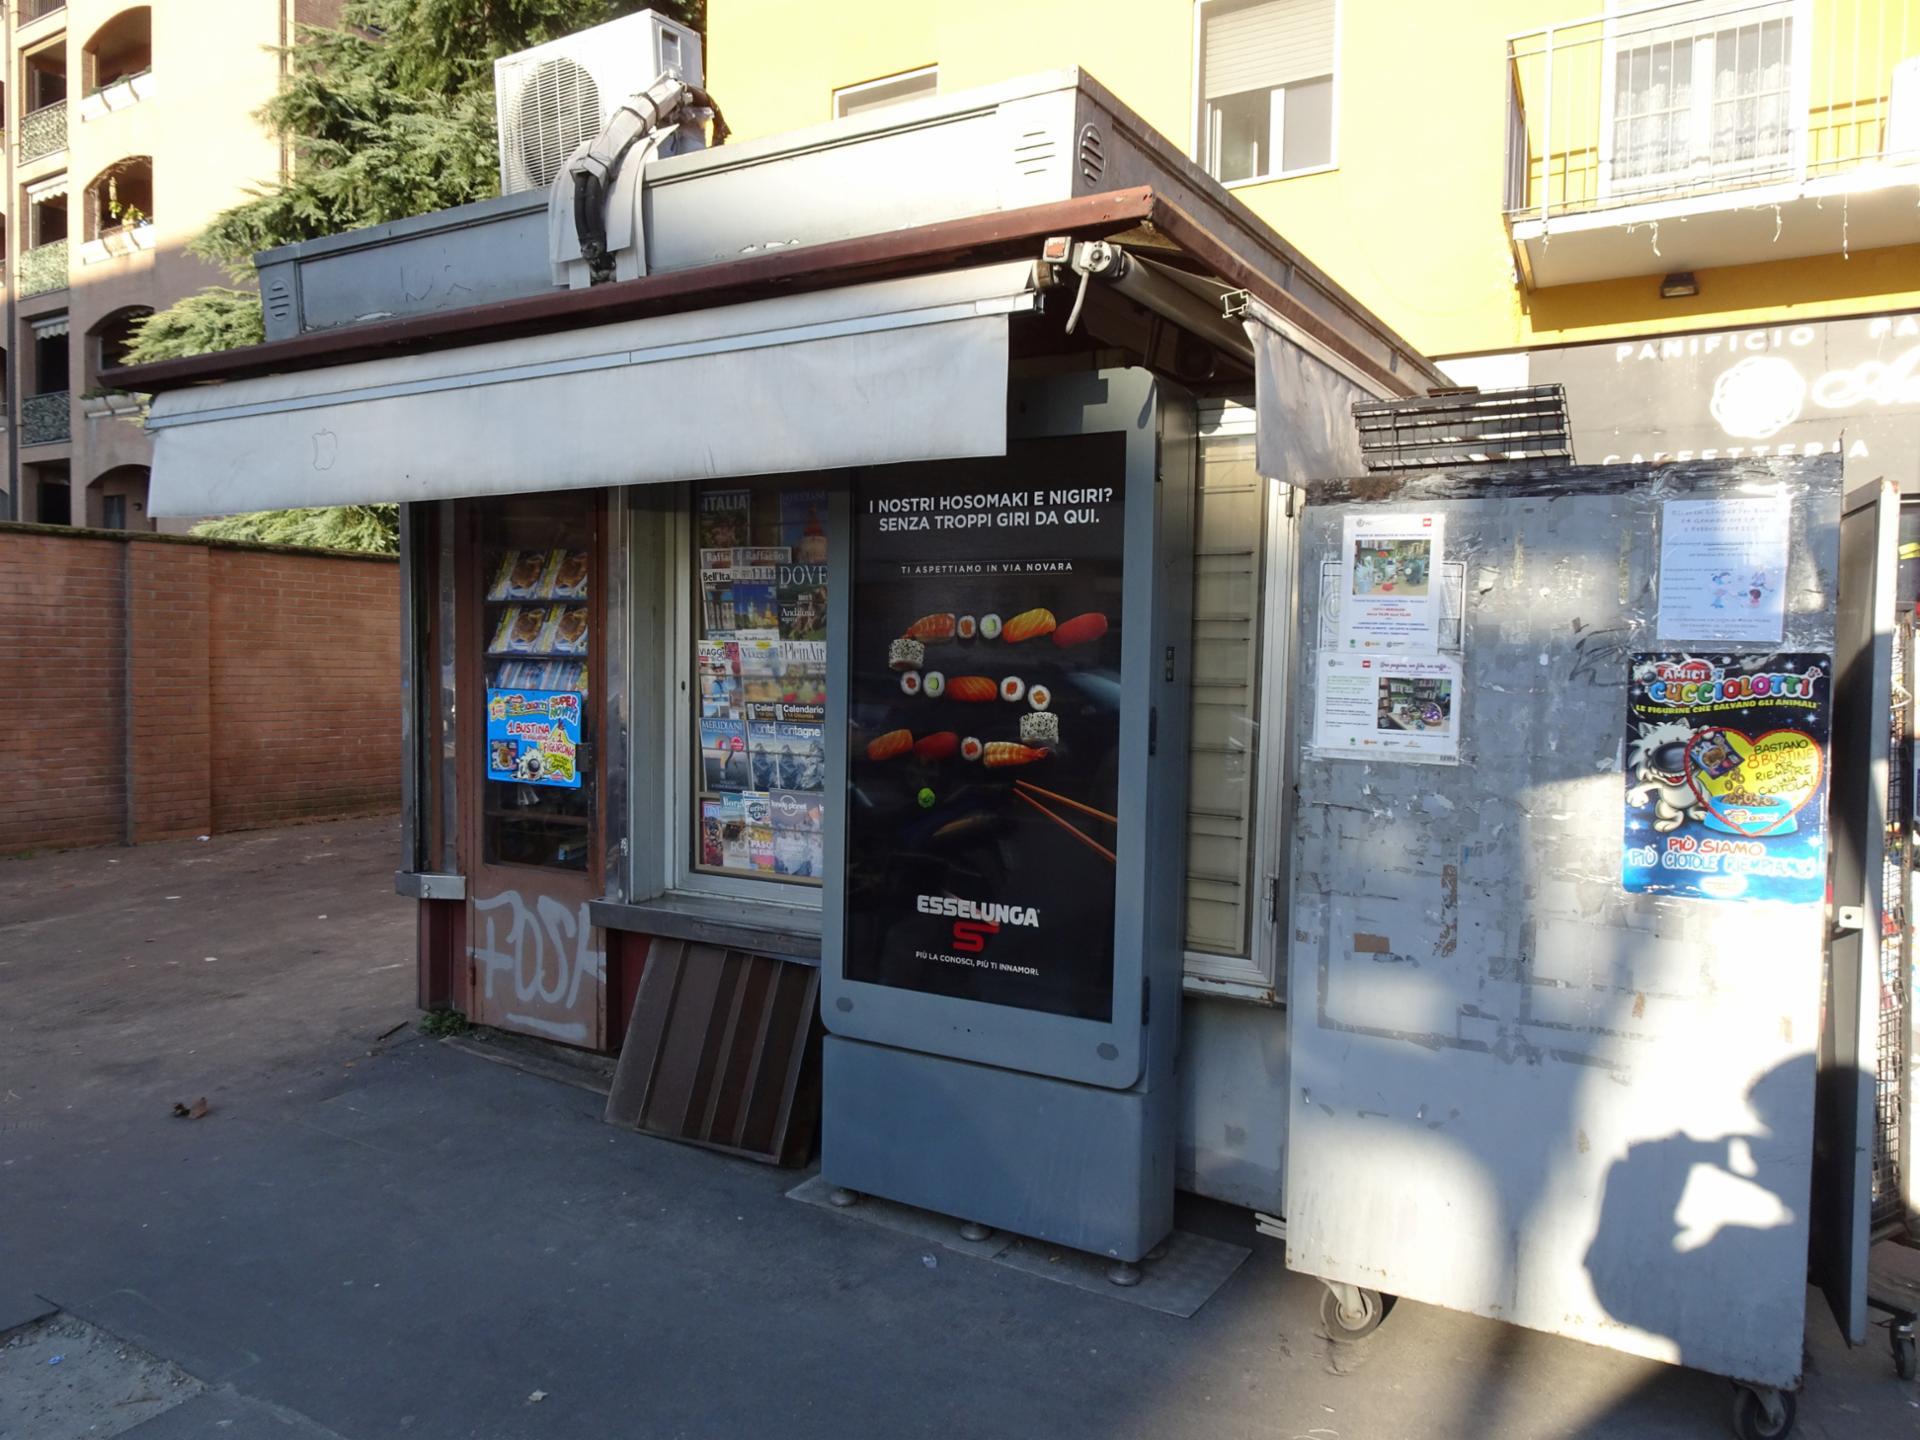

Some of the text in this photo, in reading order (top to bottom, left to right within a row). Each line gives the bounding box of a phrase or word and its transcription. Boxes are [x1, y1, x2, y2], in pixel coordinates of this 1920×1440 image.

[1616, 326, 1815, 362] PANIFICIO
[704, 494, 747, 511] ITALIA
[869, 488, 1113, 513] I NOSTRI HOSOMAKI E NIGIRI?
[879, 509, 1100, 531] SENZA TROPPI GIRI DA QUI.
[780, 565, 828, 585] DOVE
[901, 562, 1073, 574] TI ASPETTIAMO IN VIA NOVARA
[1663, 668, 1706, 680] AMICI
[1649, 673, 1812, 704] CUCCIOLOTTI
[783, 704, 824, 714] Calendario
[1636, 699, 1817, 714] LE FIGURINE CHE SALVANO GLI ANIMALI
[515, 722, 549, 734] BUSTINA
[702, 720, 742, 730] MERIDIANI
[1754, 739, 1808, 755] BASTANO
[1747, 748, 1816, 769] 8 BUSTINE
[1755, 765, 1812, 782] RIEMPIRE
[1758, 776, 1817, 795] CIOTOLA!
[1668, 836, 1763, 856] PIÙ SIAMO
[1631, 846, 1657, 865] PIÙ
[1664, 852, 1717, 870] CIOTOLE
[917, 894, 1040, 927] ESSELUNGA
[915, 950, 1040, 976] PIÙ LA CONOSCI, PIÙ TI INNAMORI.
